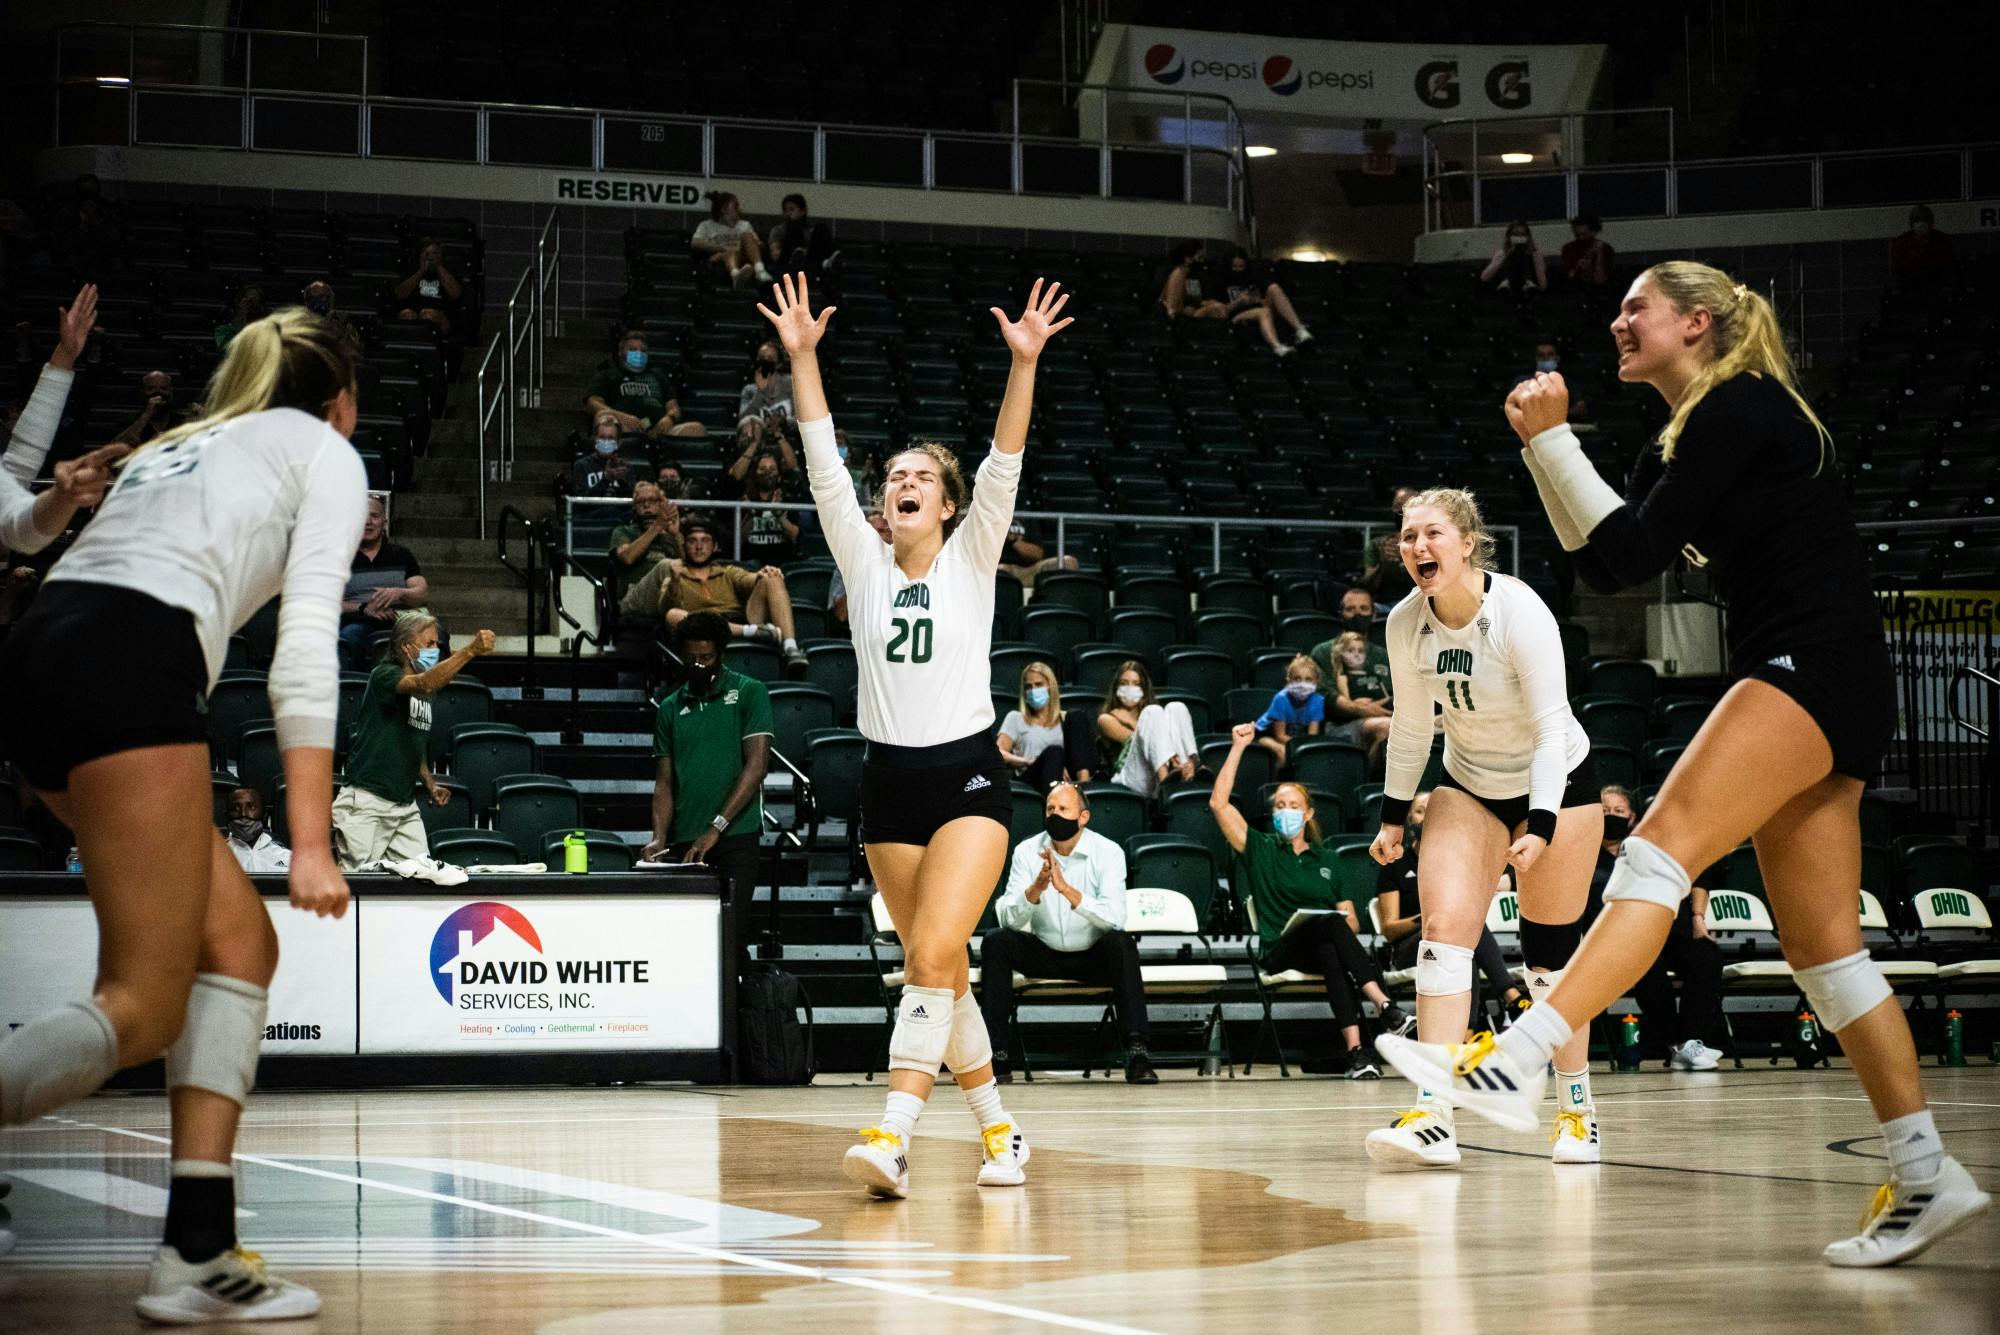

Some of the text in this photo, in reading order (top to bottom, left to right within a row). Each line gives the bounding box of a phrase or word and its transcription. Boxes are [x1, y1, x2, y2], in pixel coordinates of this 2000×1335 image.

[1192, 57, 1257, 82] pepsi
[1308, 66, 1374, 92] pepsi
[1414, 61, 1460, 109] G
[1485, 61, 1531, 110] G
[640, 123, 666, 142] 205
[558, 179, 700, 205] RESERVED
[1980, 208, 2000, 227] R
[894, 582, 930, 611] OHIO
[1882, 597, 2000, 622] URNITG
[886, 617, 933, 663] 20
[1436, 648, 1473, 677] OHIO
[1446, 680, 1475, 711] 11
[409, 696, 432, 724] OHIO
[964, 779, 992, 793] adidas
[1499, 896, 1518, 922] OH
[1710, 895, 1751, 921] OHIO
[1931, 893, 1971, 917] OHIO
[460, 960, 649, 985] DAVID WHITE
[460, 992, 596, 1012] SERVICES, INC.
[460, 1022, 649, 1036] Heating Cooling Geothermal Fireplaces
[1801, 1028, 1812, 1041] G
